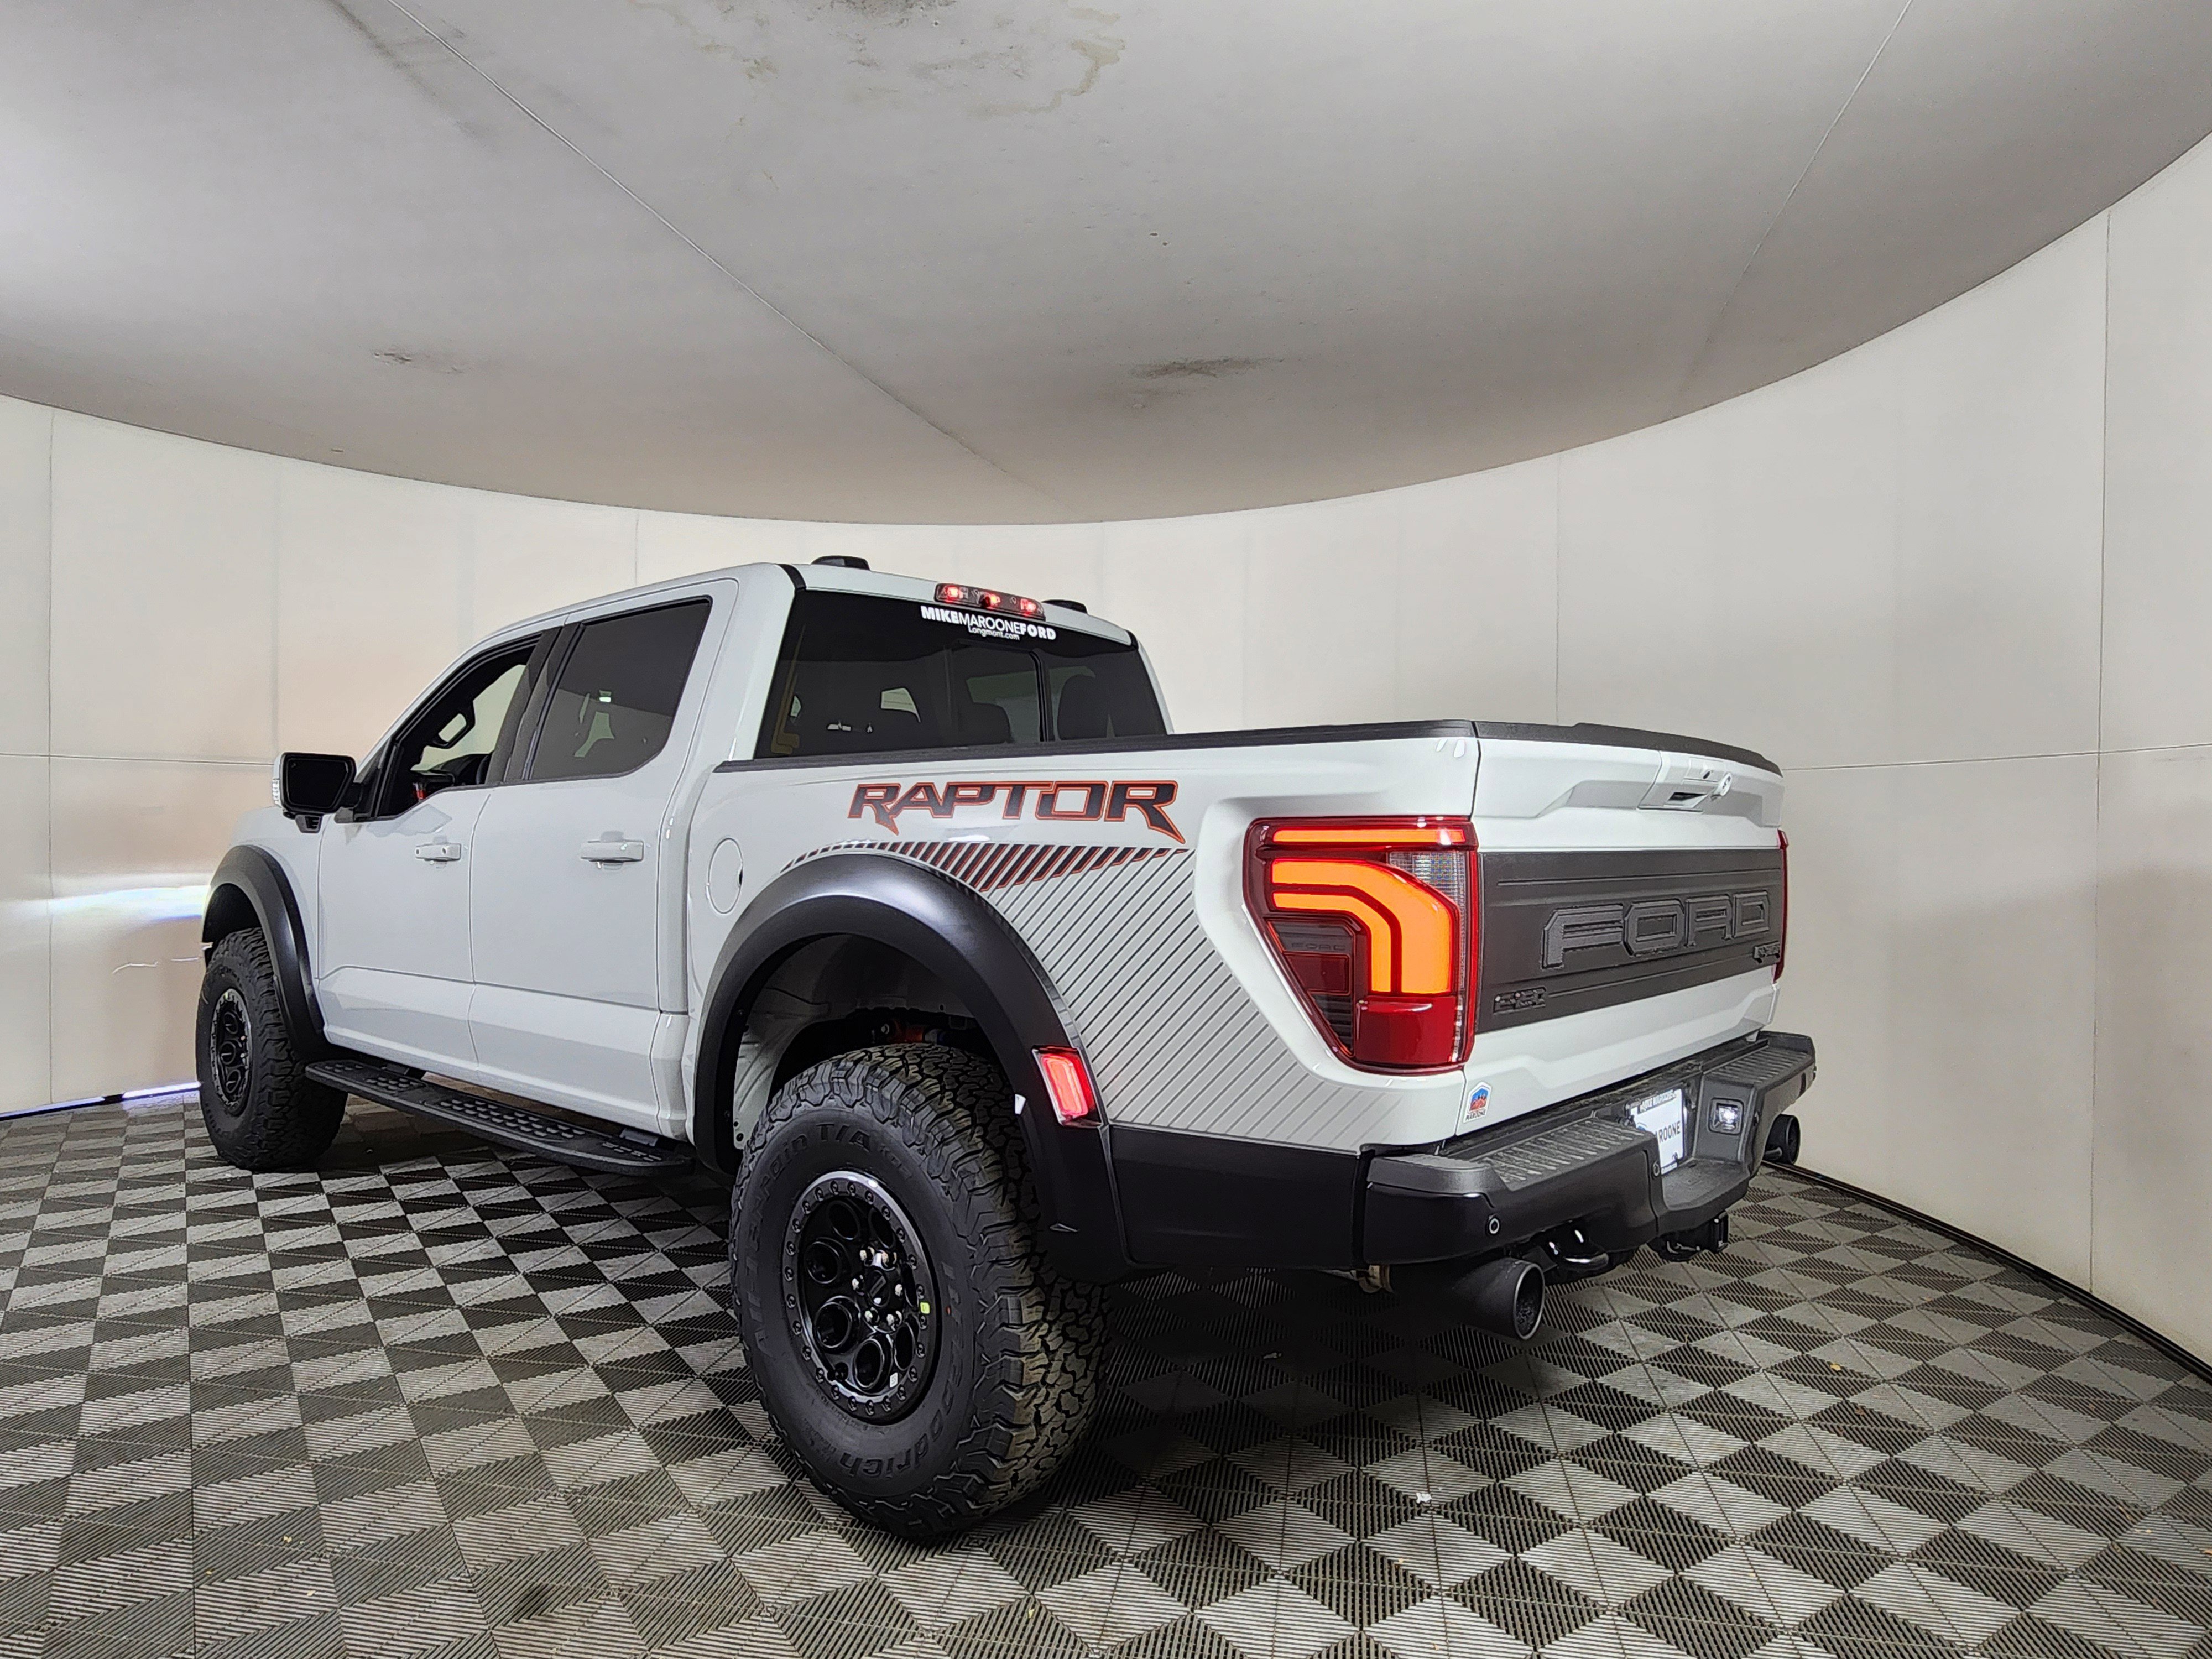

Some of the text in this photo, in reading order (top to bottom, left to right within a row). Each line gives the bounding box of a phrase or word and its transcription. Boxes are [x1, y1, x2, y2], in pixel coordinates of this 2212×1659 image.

[968, 625, 1020, 640] Longmont.com
[847, 780, 1186, 844] RAPTOR
[1541, 890, 1770, 969] FORD
[816, 1122, 871, 1152] T/A
